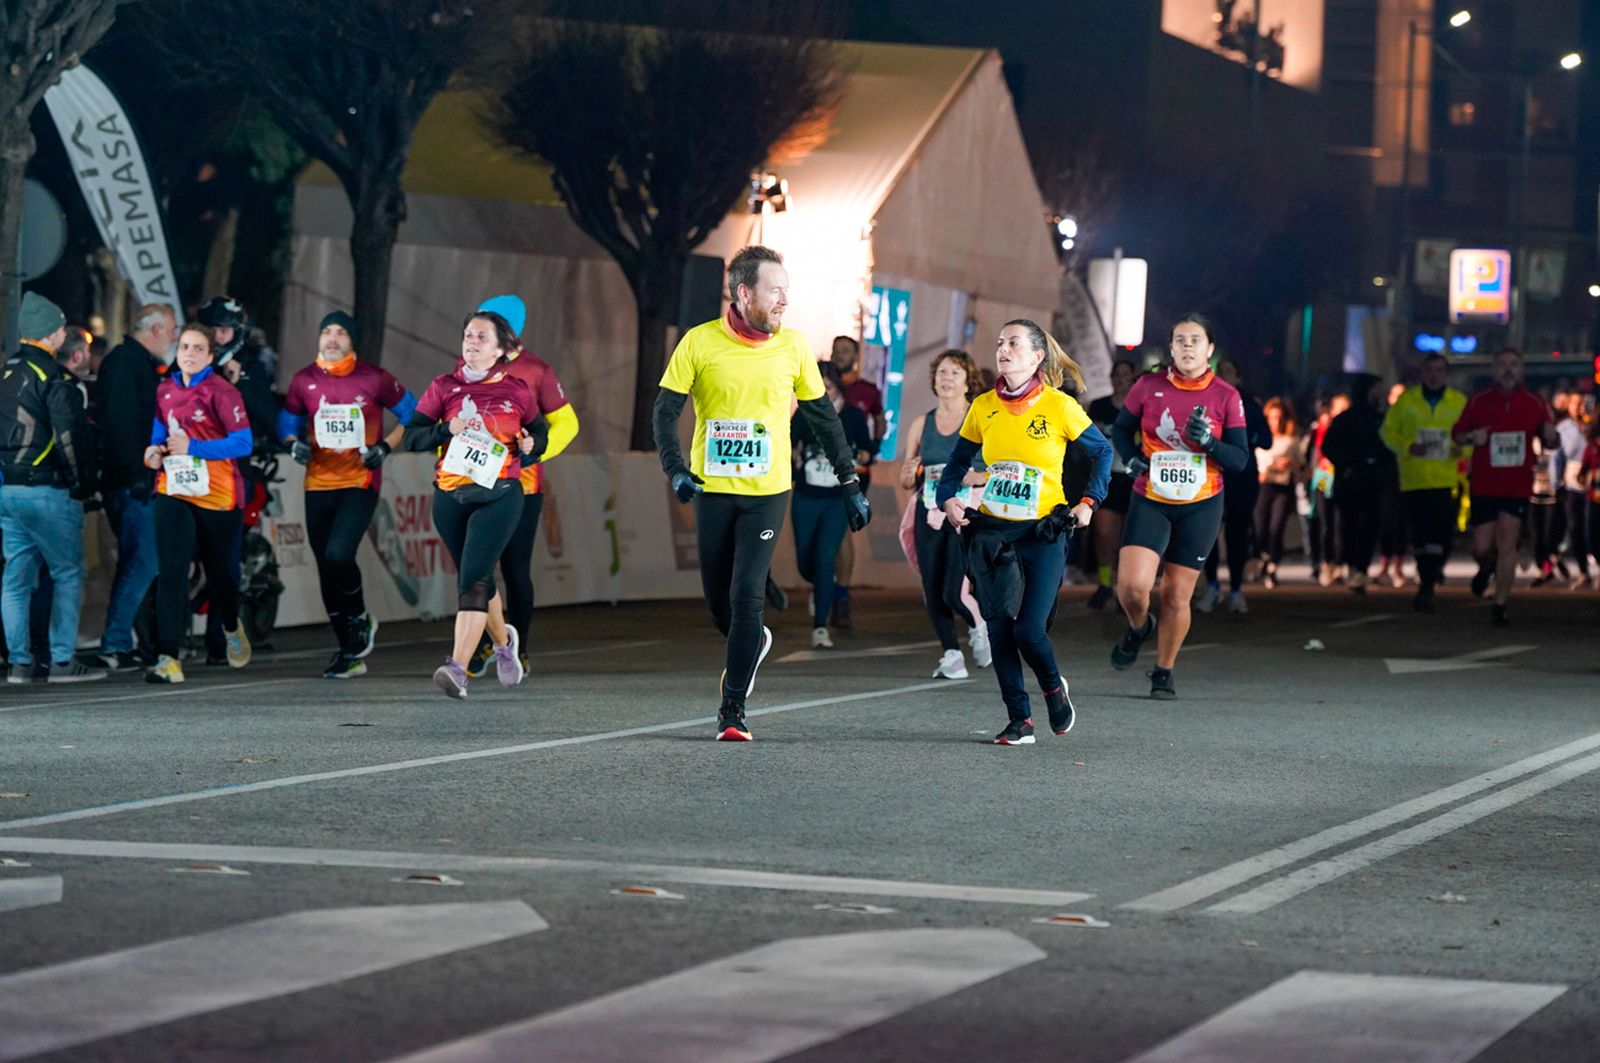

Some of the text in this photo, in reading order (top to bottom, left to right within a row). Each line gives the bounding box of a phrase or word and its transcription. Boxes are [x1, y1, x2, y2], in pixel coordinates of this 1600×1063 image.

[96, 113, 172, 298] APEMASA
[325, 420, 354, 433] 1634
[464, 446, 489, 467] 743
[715, 439, 761, 457] 12241
[1160, 468, 1197, 484] 6695
[395, 495, 433, 534] SAN
